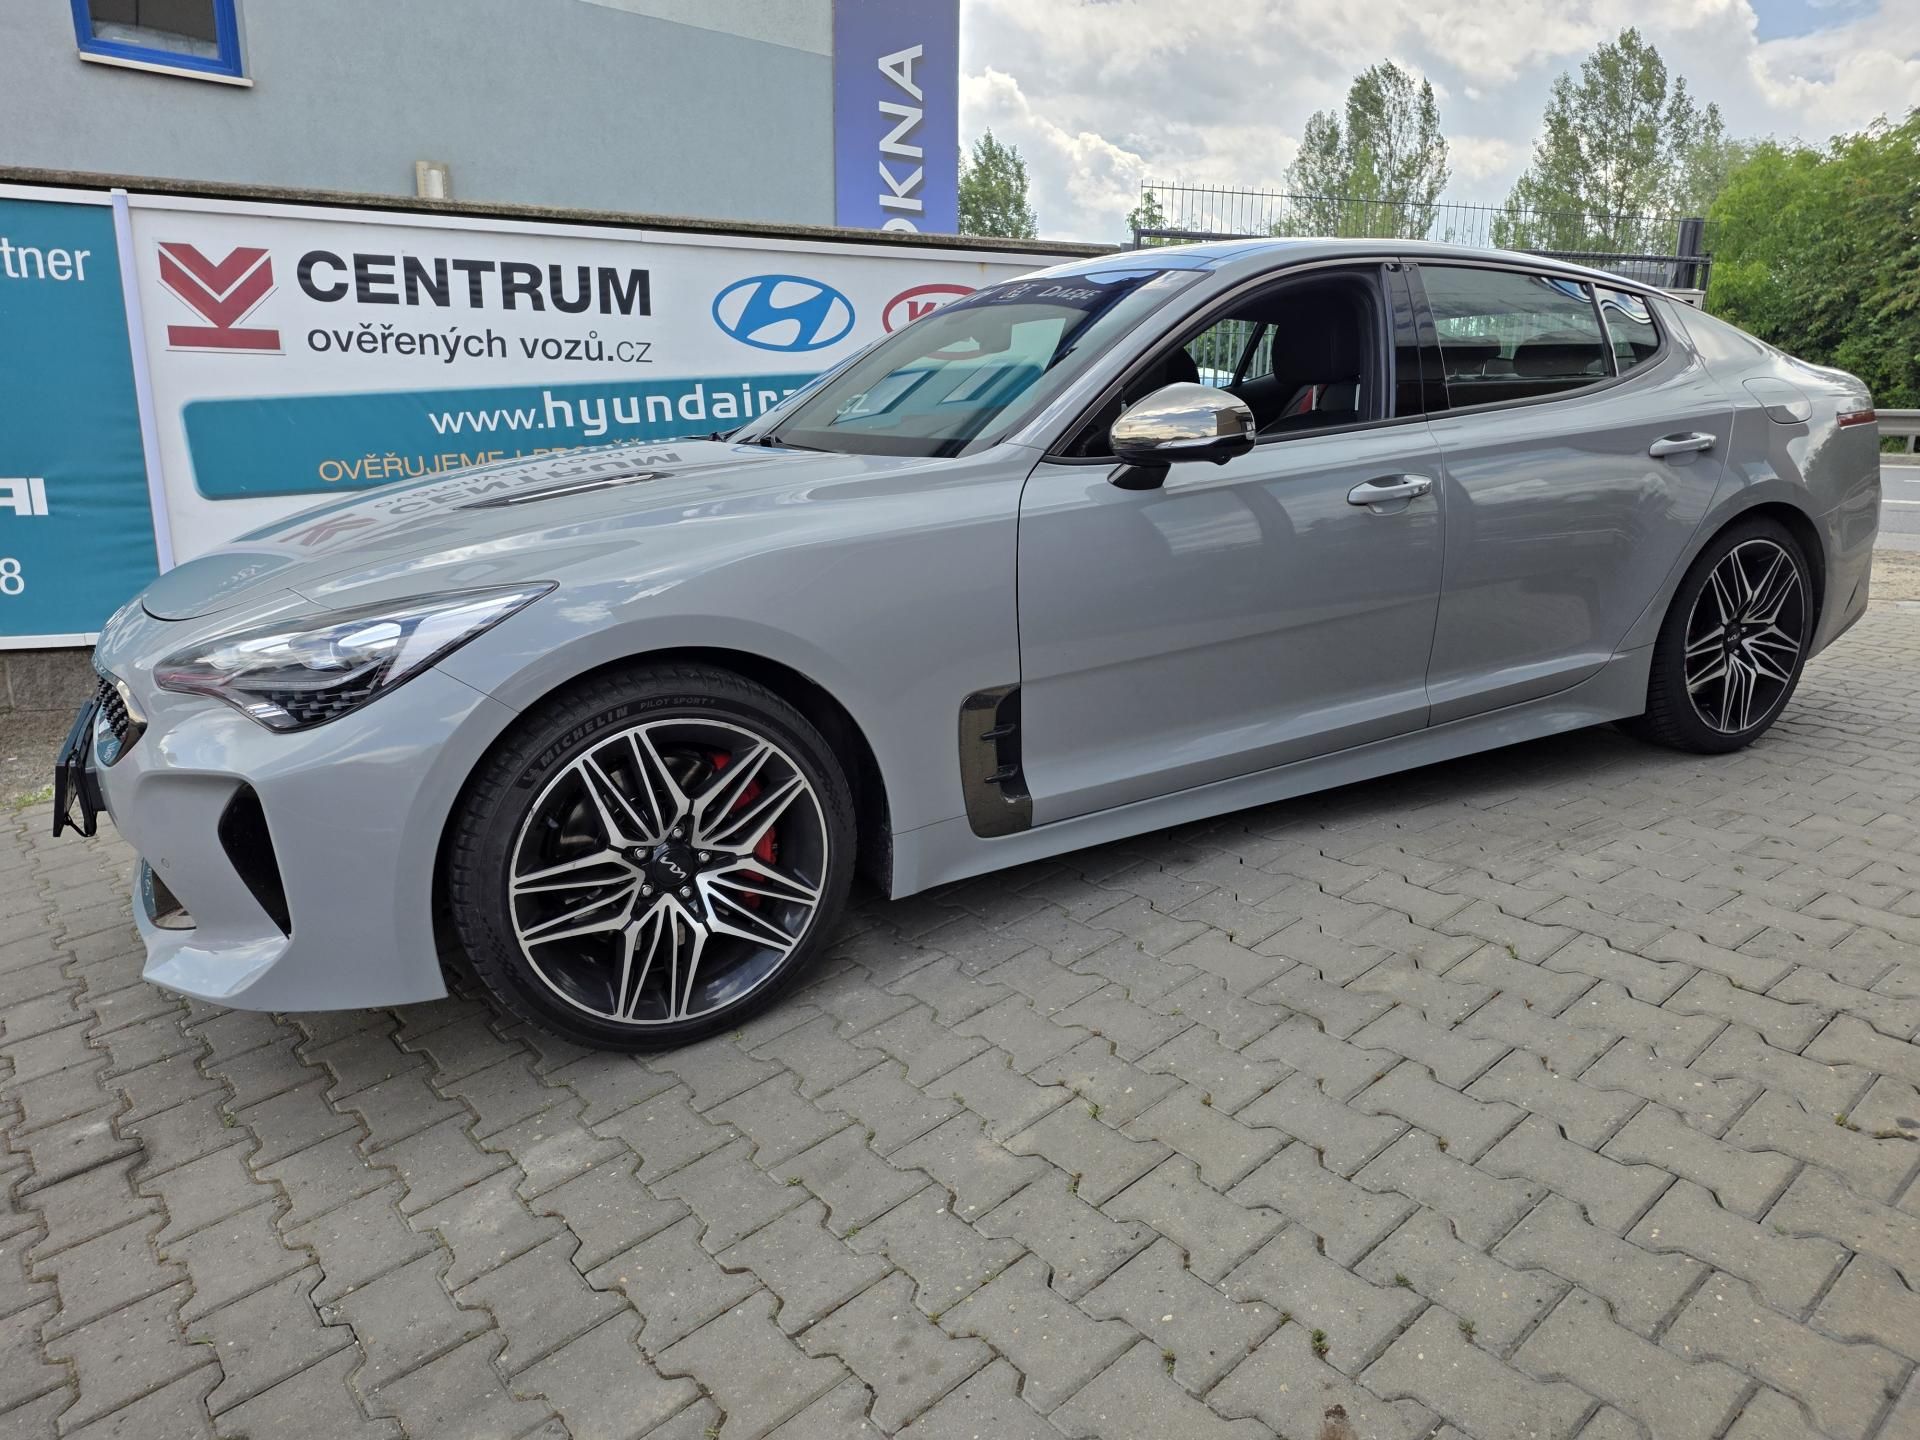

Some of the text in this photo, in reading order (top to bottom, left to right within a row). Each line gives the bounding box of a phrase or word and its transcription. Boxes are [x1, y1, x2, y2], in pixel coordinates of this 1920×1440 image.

[296, 249, 653, 317] CENTRUM
[307, 322, 654, 364] ověřených vozů.cz
[428, 382, 798, 437] www.hyundair
[540, 705, 629, 768] MICHELIN
